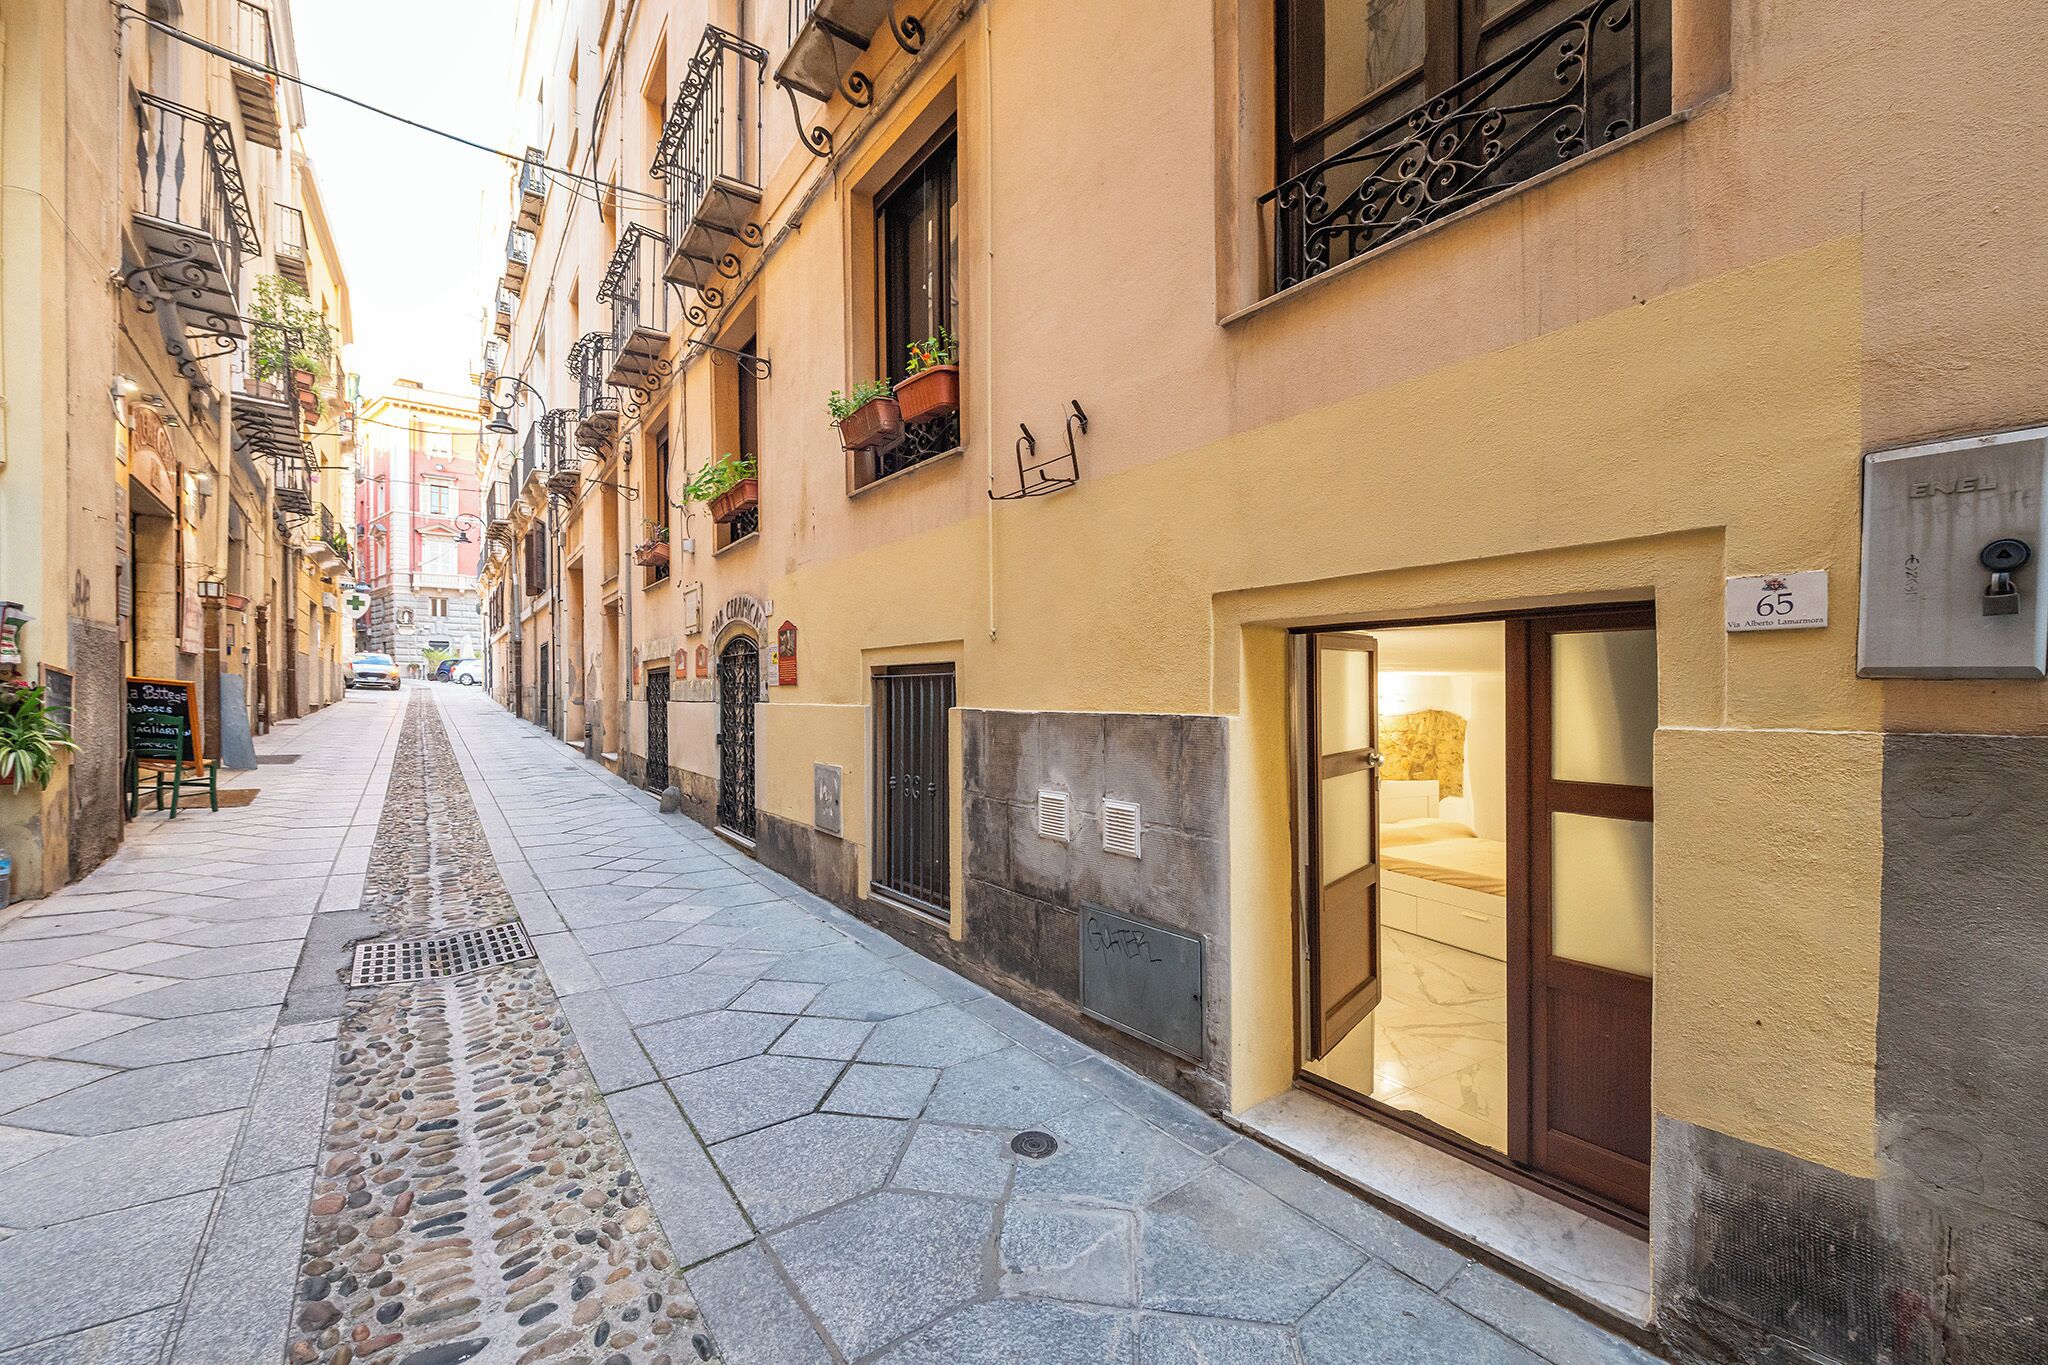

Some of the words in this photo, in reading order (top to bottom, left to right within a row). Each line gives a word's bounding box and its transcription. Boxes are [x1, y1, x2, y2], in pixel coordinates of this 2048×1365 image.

[1910, 475, 1998, 499] ENEL
[1756, 592, 1794, 617] 65
[1744, 620, 1774, 628] Alberto
[1777, 617, 1824, 626] Lamarmora
[127, 688, 139, 699] a
[142, 685, 188, 705] Bottega
